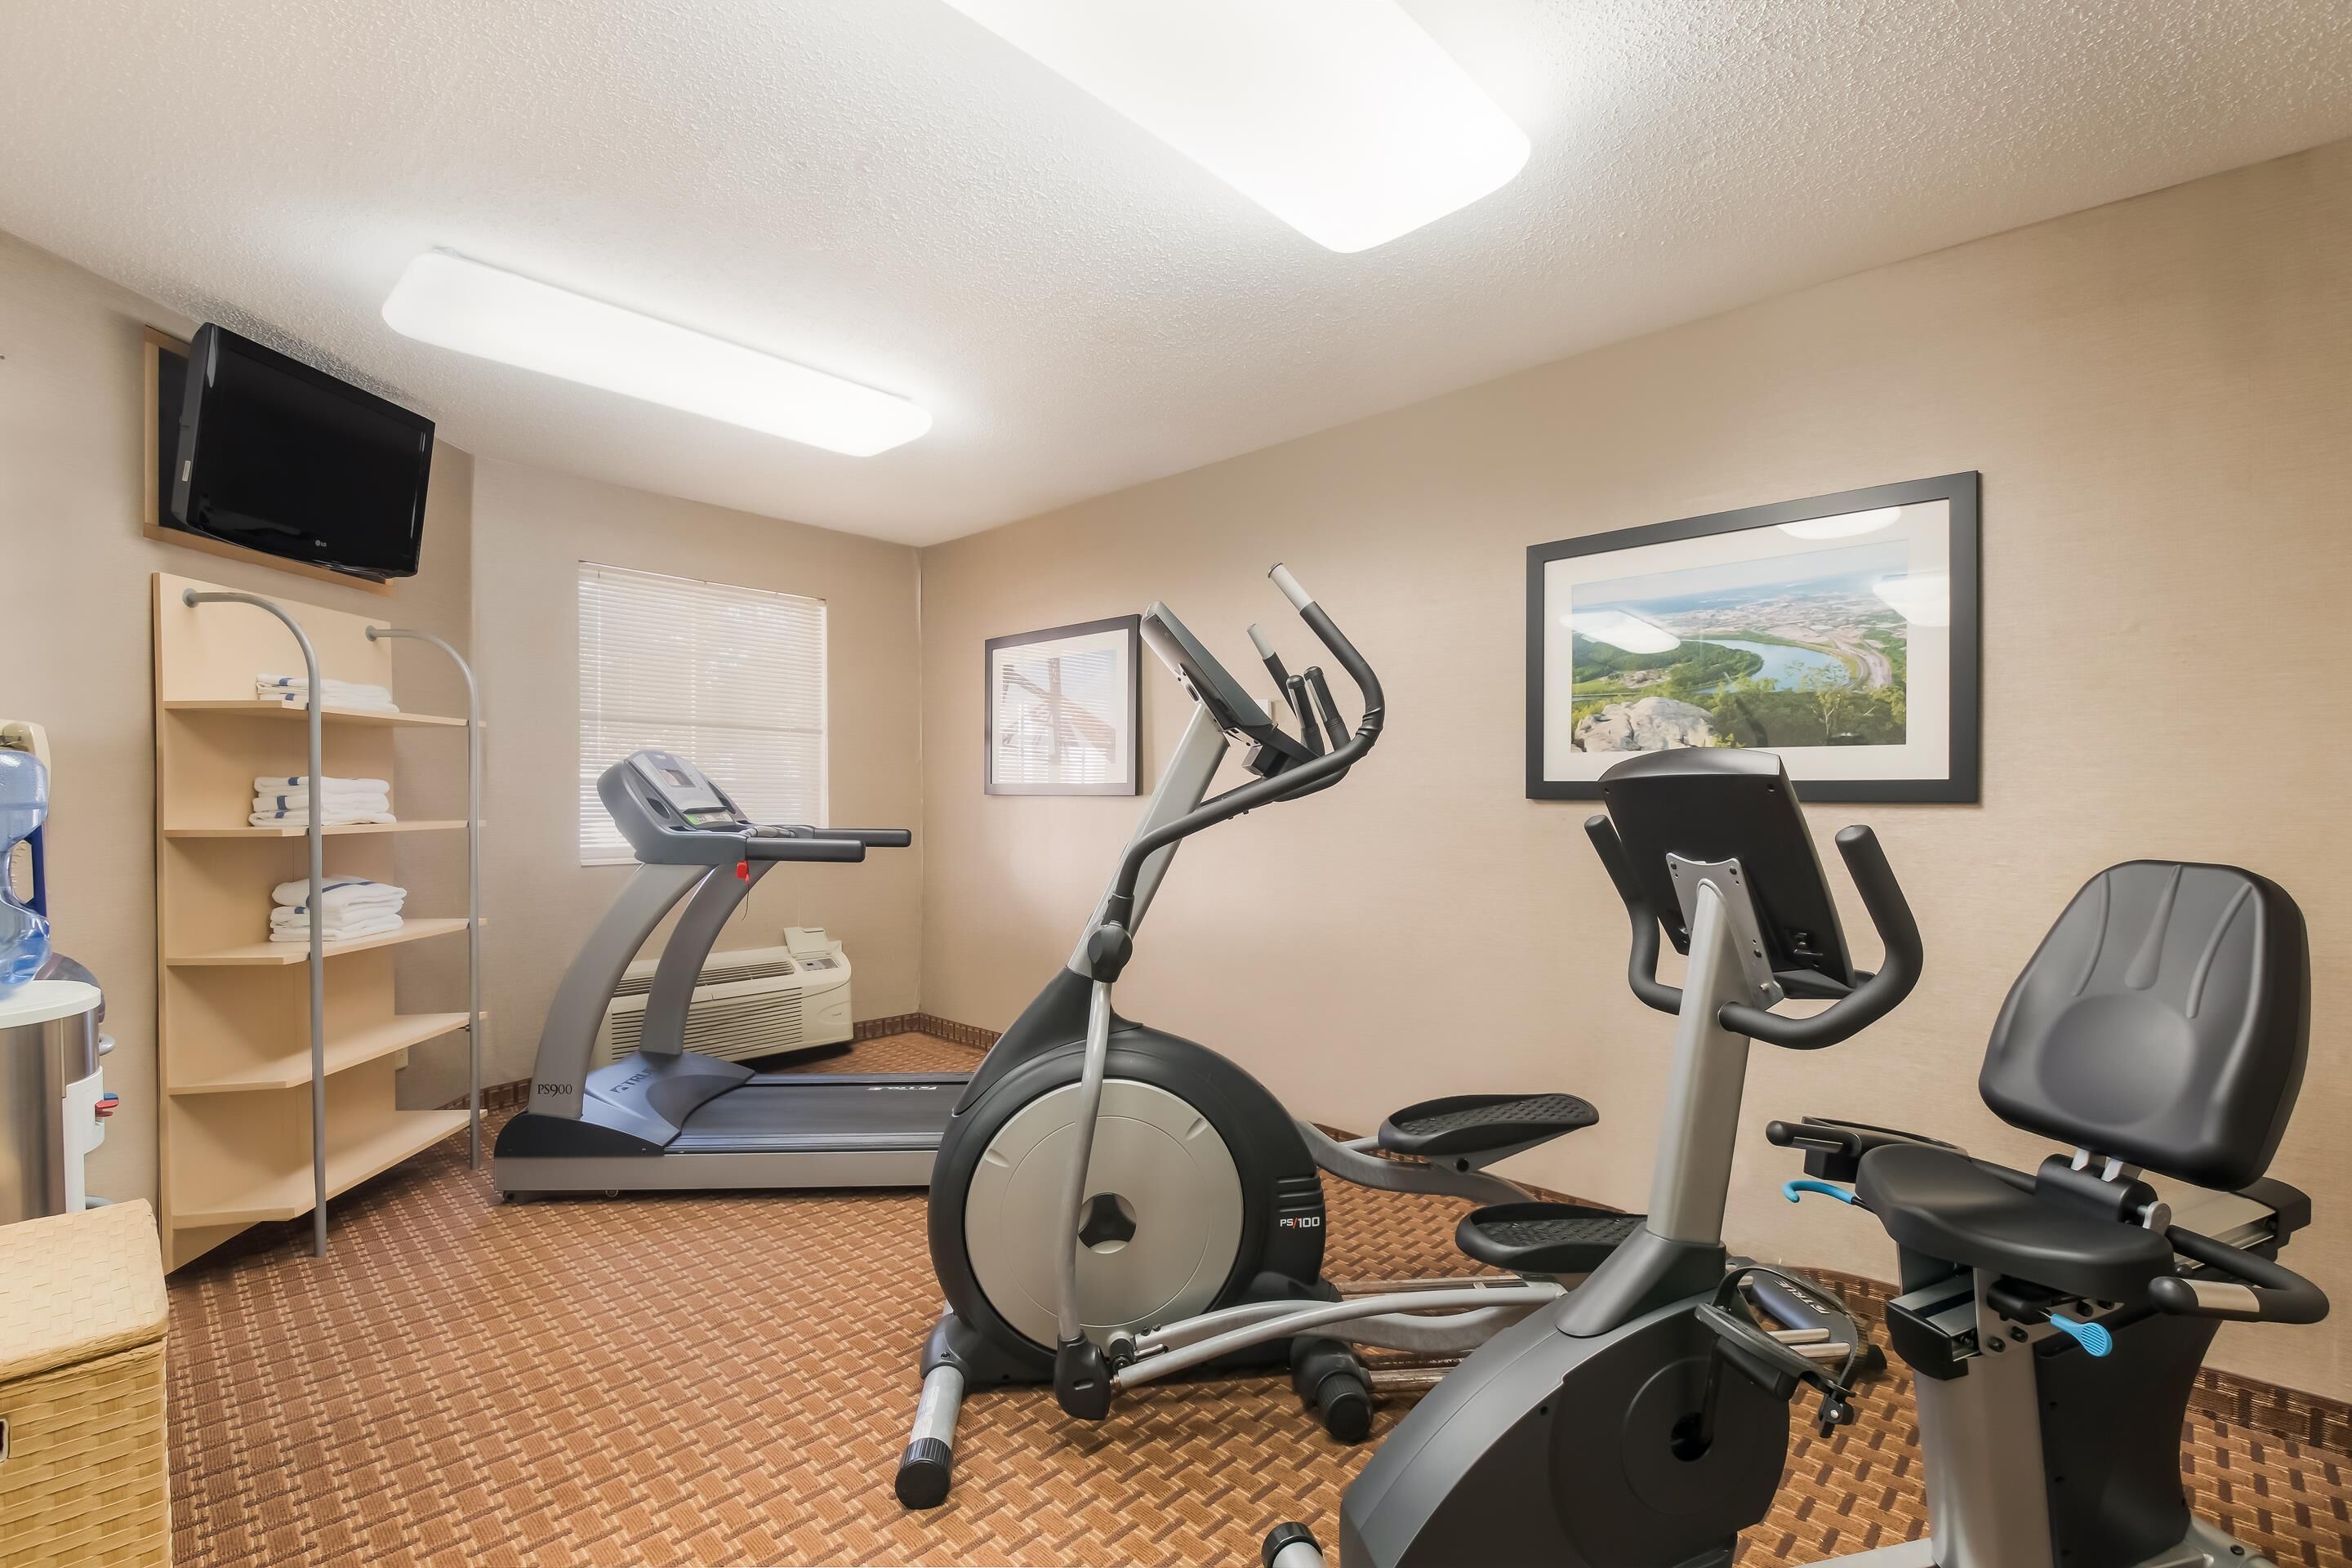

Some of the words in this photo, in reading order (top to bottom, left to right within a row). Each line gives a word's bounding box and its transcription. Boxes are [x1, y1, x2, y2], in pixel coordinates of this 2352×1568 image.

[537, 1084, 573, 1098] PS900
[1280, 1216, 1321, 1229] PS/100
[1773, 1280, 1814, 1305] TRUE
